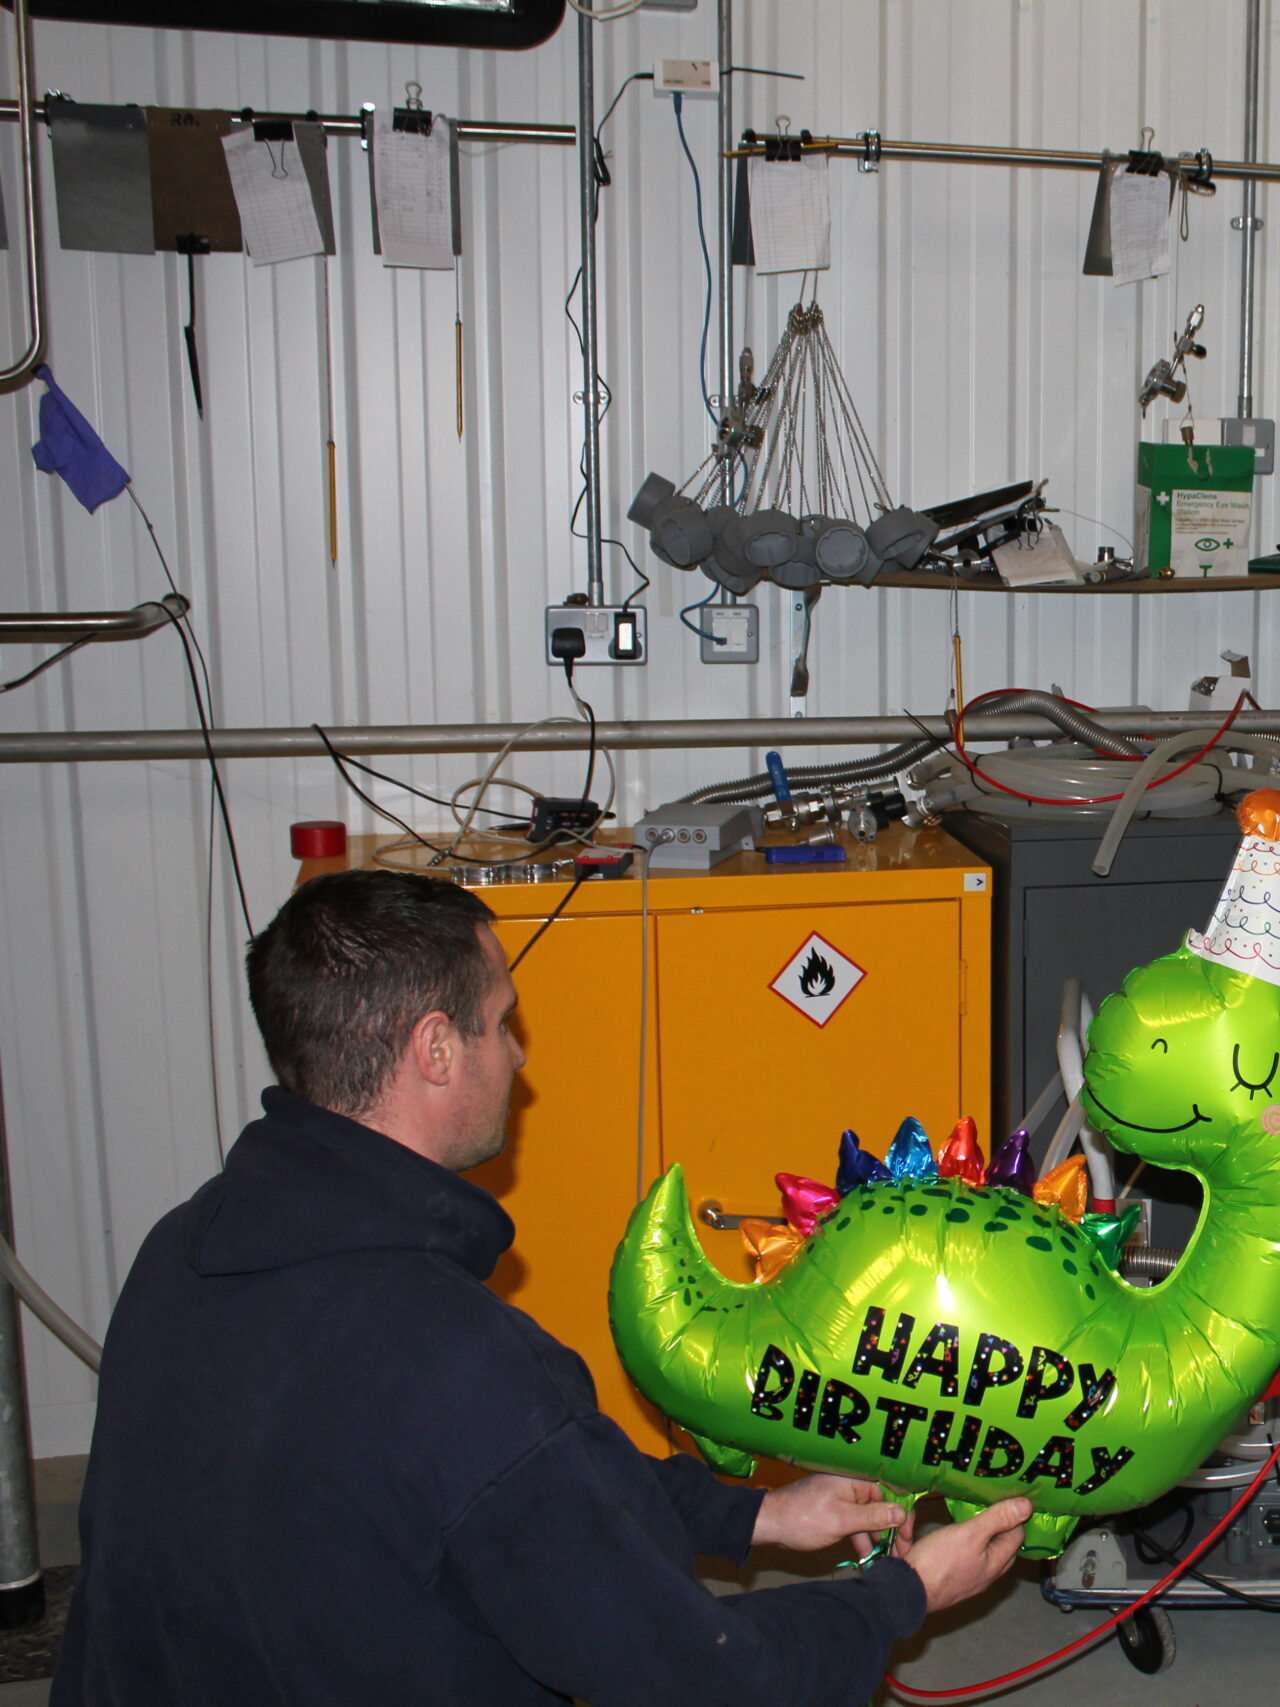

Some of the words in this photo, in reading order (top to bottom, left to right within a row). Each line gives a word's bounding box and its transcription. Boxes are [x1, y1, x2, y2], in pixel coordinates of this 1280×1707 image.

[1177, 491, 1218, 500] HypaClens
[1176, 500, 1215, 509] Emergency
[1215, 501, 1229, 510] Eye
[1231, 502, 1250, 510] Wash
[1176, 508, 1200, 516] Station
[852, 1306, 1116, 1432] HAPPY
[751, 1344, 1136, 1495] BIRTHDAY
